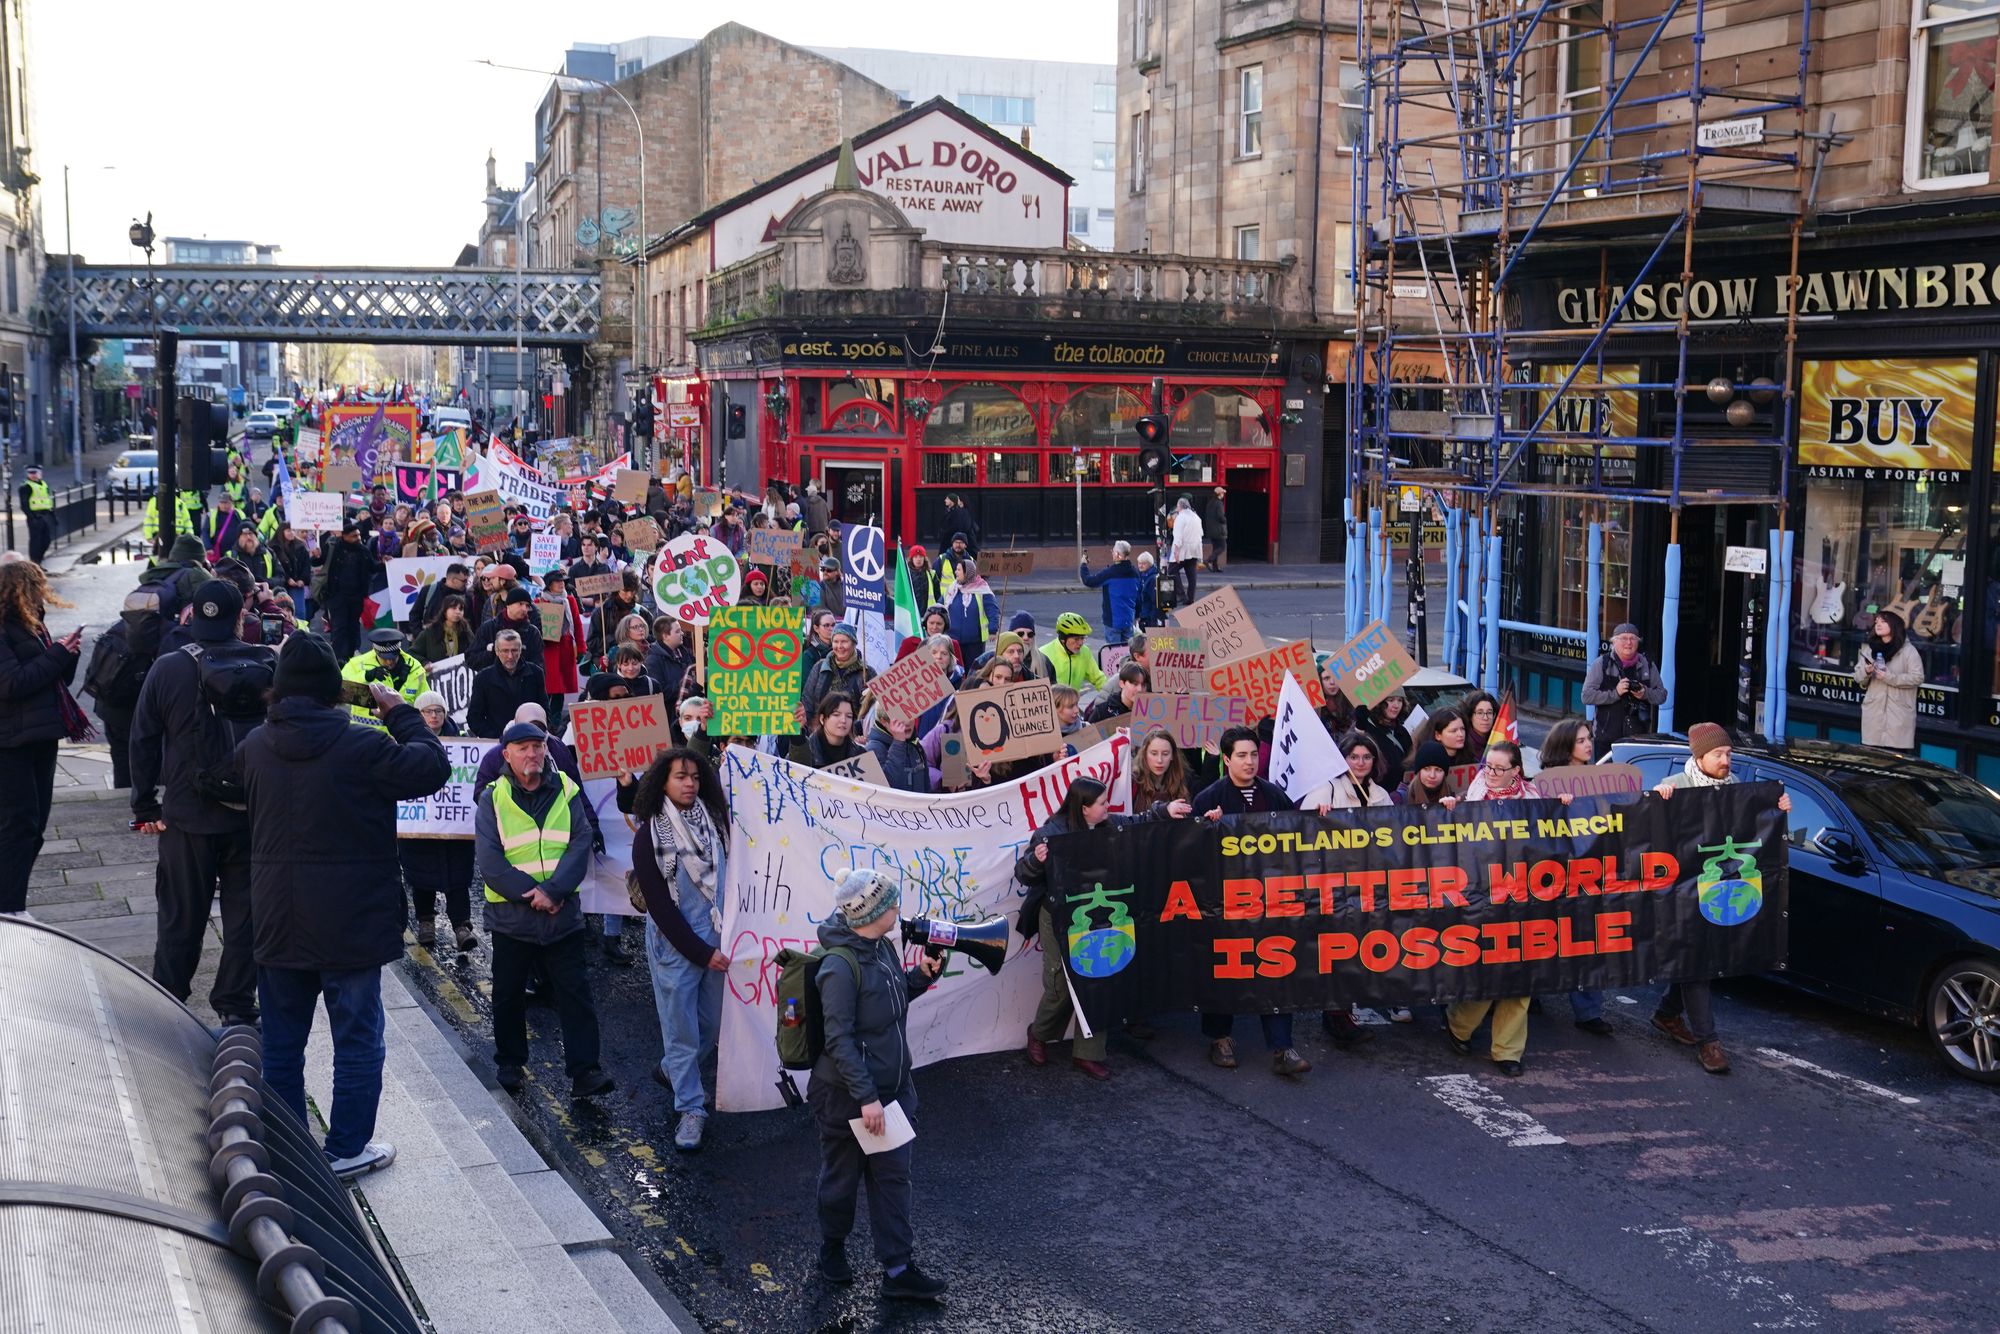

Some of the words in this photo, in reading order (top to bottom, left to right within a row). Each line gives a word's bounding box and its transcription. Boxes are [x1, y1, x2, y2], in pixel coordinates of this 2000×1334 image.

[1703, 123, 1758, 140] TRONGATE
[857, 144, 923, 187] VAL
[931, 141, 1018, 194] D'ORO
[886, 177, 985, 196] RESTAURANT
[900, 196, 936, 211] TAKE
[942, 199, 984, 214] AWAY
[1557, 277, 1759, 325] GLASGOW
[1775, 261, 2000, 316] PAWNBR
[799, 341, 838, 356] est.
[841, 341, 887, 360] 1906
[950, 344, 982, 357] FINE
[985, 345, 1019, 358] ALES
[1053, 342, 1084, 362] the
[1187, 350, 1230, 363] CHOICE
[1232, 351, 1269, 364] MALTS
[1826, 396, 1945, 448] BUY
[1563, 456, 1629, 468] CONDTION
[1808, 466, 1856, 478] ASIAN
[1864, 467, 1876, 479] &
[1884, 469, 1961, 482] FOREIGN
[499, 471, 558, 505] TRADES
[467, 497, 479, 506] THE
[481, 515, 489, 524] IS
[534, 543, 558, 551] EARTH
[536, 536, 555, 544] SAVE
[534, 550, 557, 559] TODAY
[844, 572, 858, 585] No
[678, 584, 731, 621] out
[845, 586, 883, 602] Nuclear
[1195, 595, 1226, 617] GAYS
[709, 606, 754, 628] ACT
[756, 606, 805, 629] NOW
[1150, 636, 1175, 652] SAFE
[1210, 630, 1244, 659] GAS
[1541, 643, 1553, 654] ON
[1555, 645, 1587, 660] JEWEL
[1566, 637, 1587, 648] CAS
[1155, 651, 1206, 669] LIVEABLE
[1328, 624, 1388, 681] PLANET
[870, 654, 927, 696] RADICAL
[1210, 642, 1308, 691] CLIMATE
[1355, 652, 1385, 682] OVER
[708, 669, 801, 695] CHANGE
[878, 666, 944, 711] ACTION
[1156, 669, 1206, 690] PLANET
[1801, 671, 1854, 688] INSTANT
[715, 695, 750, 711] FOR
[756, 695, 790, 711] THE
[900, 681, 945, 720] NOW
[1007, 693, 1016, 707] I
[1022, 690, 1049, 703] HATE
[1799, 684, 1817, 696] ON
[1821, 687, 1866, 703] QUALI
[572, 703, 658, 733] FRACK
[1011, 706, 1050, 721] CLIMATE
[1134, 696, 1166, 721] NO
[1174, 696, 1249, 723] FALSE
[721, 711, 796, 736] BETTER
[576, 730, 621, 754] OFF
[461, 746, 480, 764] TO
[435, 805, 472, 822] JEFF
[855, 788, 928, 840] please
[928, 797, 992, 830] have
[997, 800, 1013, 827] a
[1221, 827, 1394, 857] SCOTLAND'S
[1402, 818, 1530, 849] CLIMATE
[1540, 812, 1624, 839] MARCH
[736, 852, 792, 914] with
[1159, 880, 1203, 923] A
[1222, 864, 1470, 922] BETTER
[1488, 851, 1681, 907] WORLD
[1213, 935, 1298, 980] IS
[1317, 910, 1634, 975] POSSIBLE
